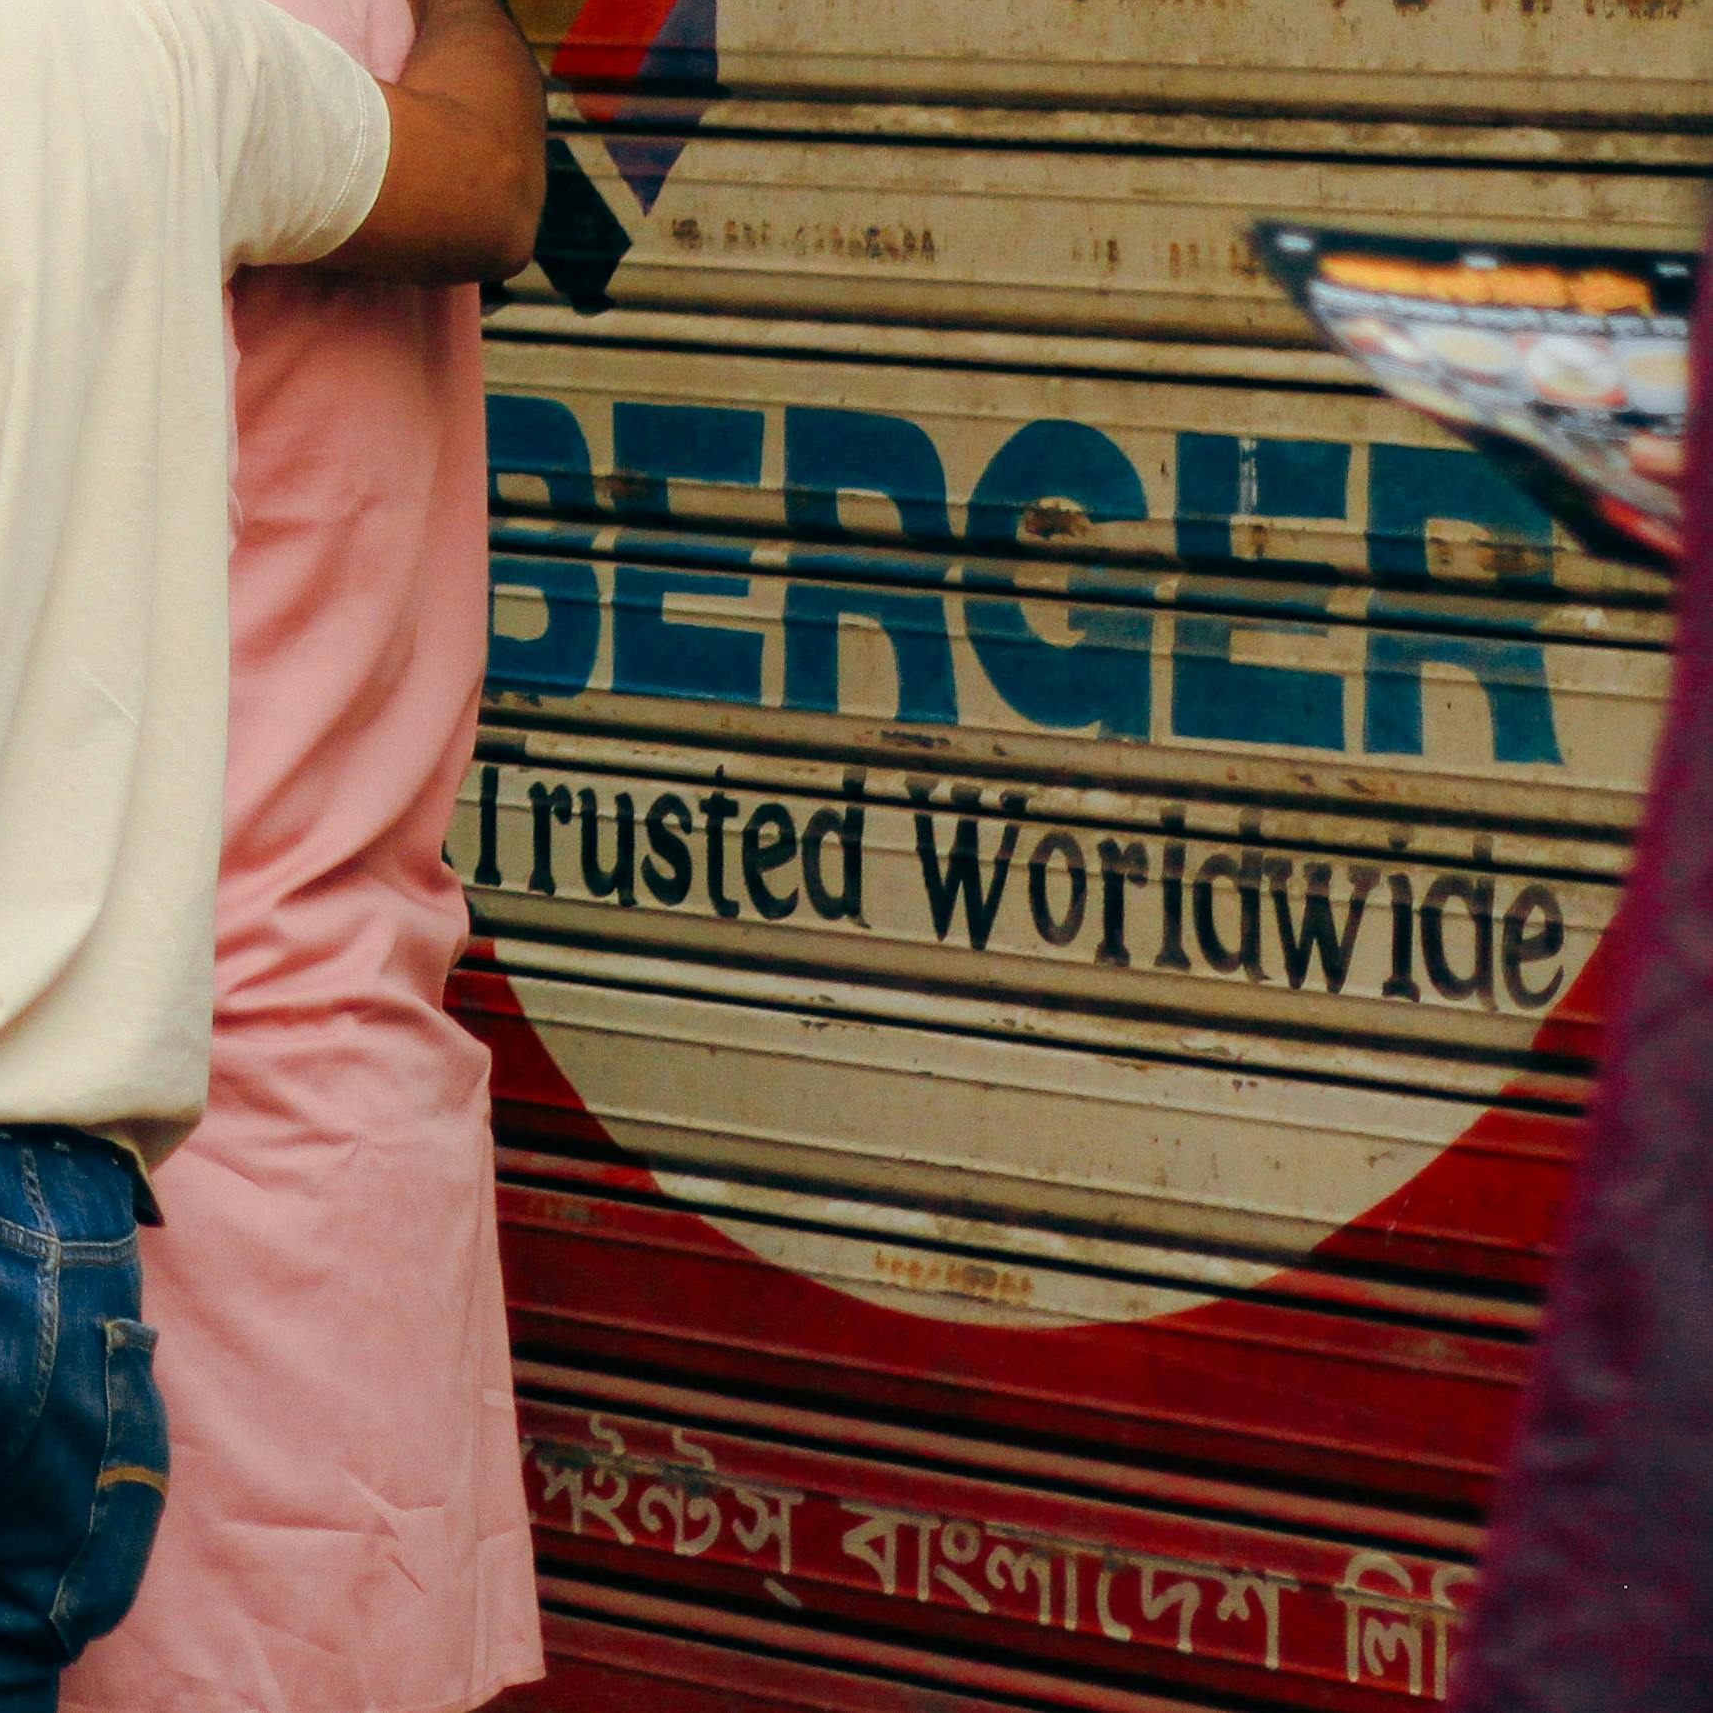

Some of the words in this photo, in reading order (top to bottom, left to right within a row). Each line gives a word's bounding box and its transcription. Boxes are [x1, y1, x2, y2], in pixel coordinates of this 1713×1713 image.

[483, 392, 1565, 766] BERGER
[472, 742, 871, 929] Trusted
[912, 769, 1568, 1013] Worldwide
[840, 1495, 1299, 1671] বাংলাদেশ
[1332, 1551, 1478, 1701] লি
